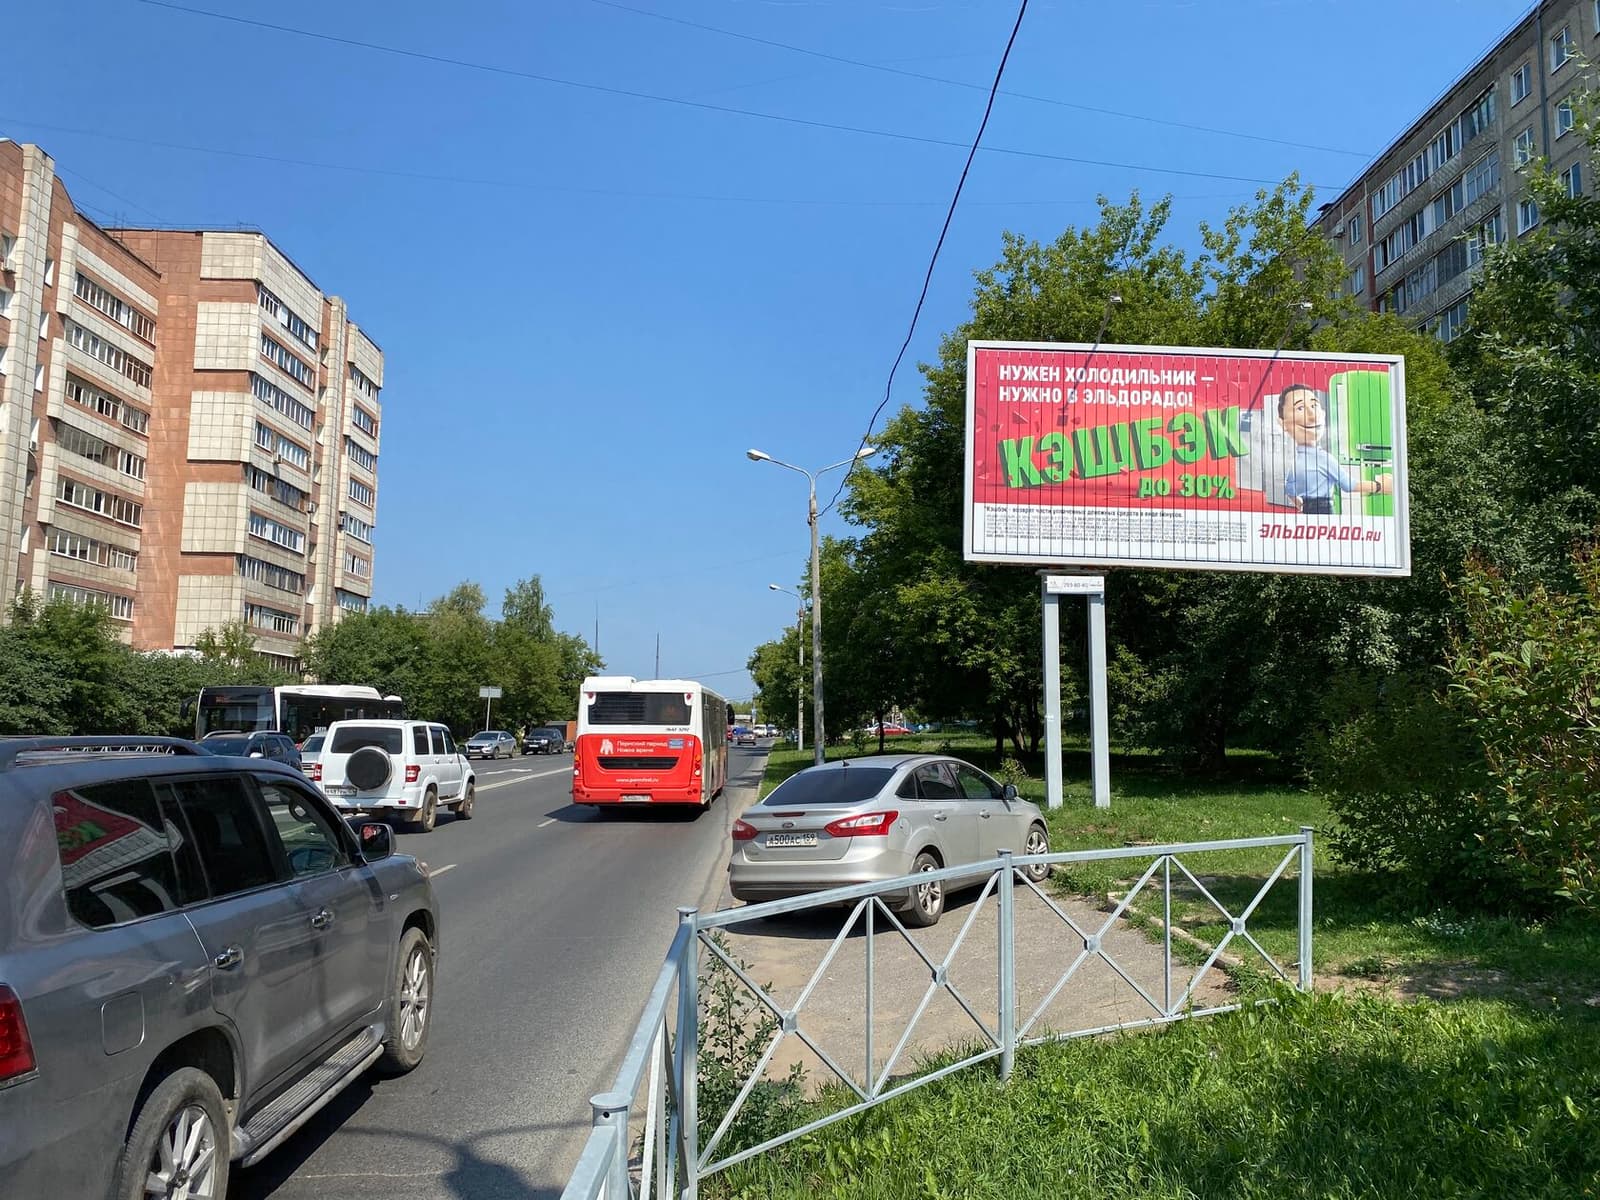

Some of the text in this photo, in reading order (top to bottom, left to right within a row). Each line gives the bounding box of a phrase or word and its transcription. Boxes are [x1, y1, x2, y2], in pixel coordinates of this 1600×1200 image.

[999, 365, 1060, 382] НУЖЕН
[1064, 367, 1196, 386] ХОЛОДИЛЬНИК
[999, 386, 1193, 409] НУЖНО В ЭЛЬДОРАДО!
[998, 405, 1250, 488] КЭШБЭК
[1178, 474, 1236, 499] 30%
